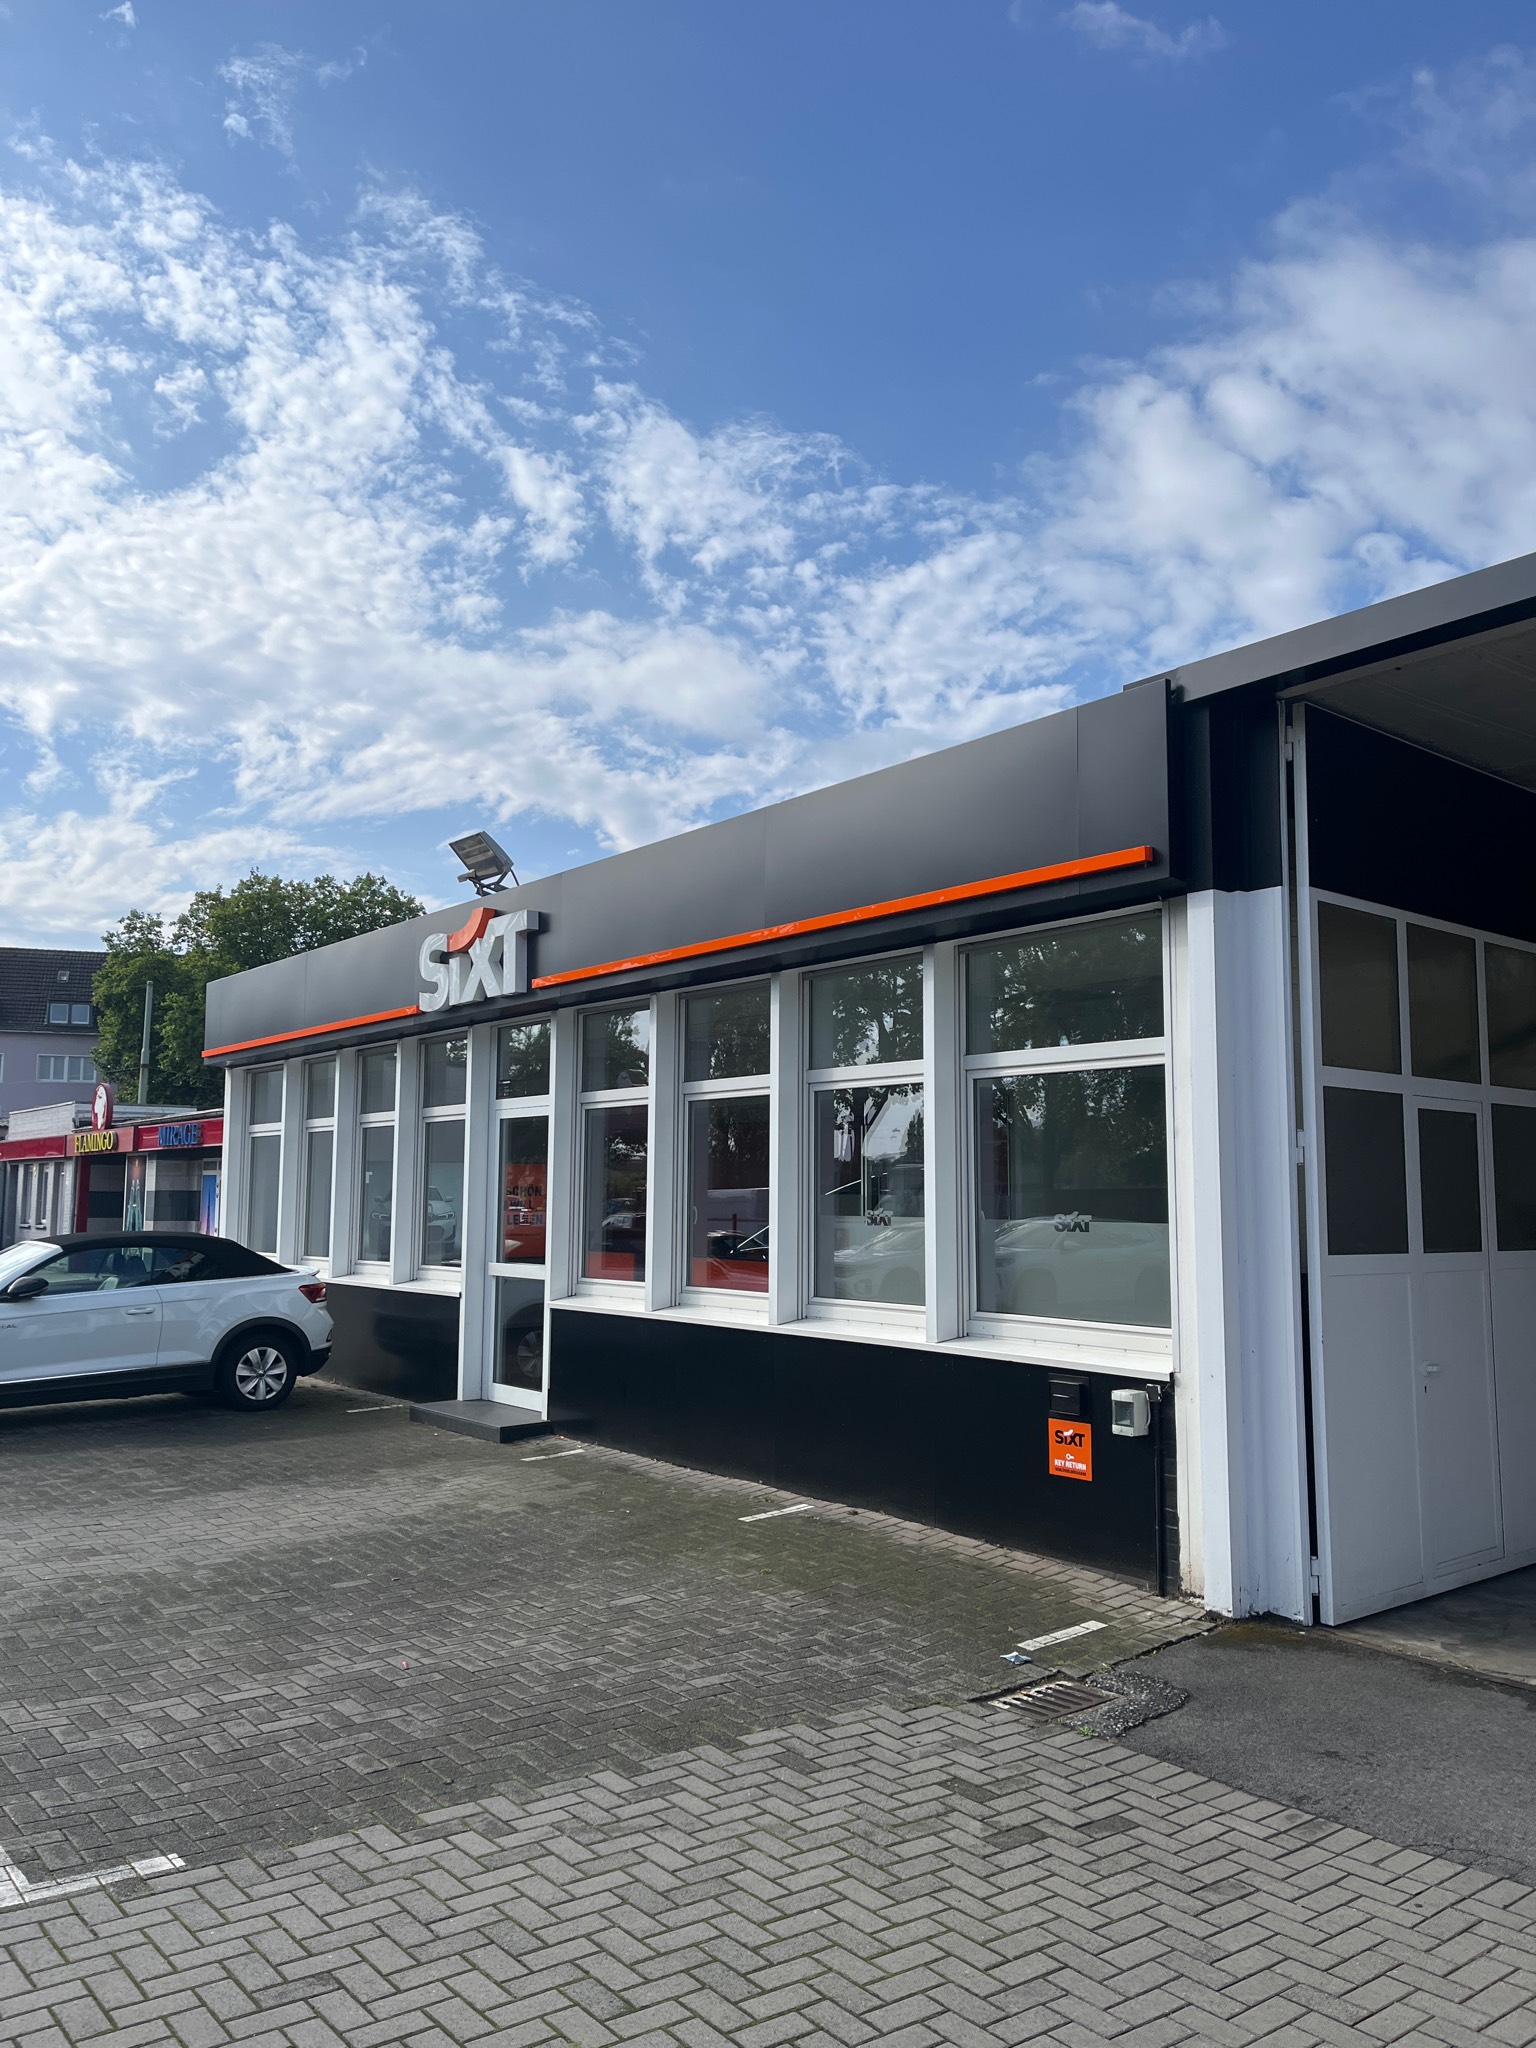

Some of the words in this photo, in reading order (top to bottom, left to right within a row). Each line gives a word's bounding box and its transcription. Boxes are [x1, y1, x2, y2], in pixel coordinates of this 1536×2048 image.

[74, 1131, 116, 1153] FLAMINGO
[158, 1123, 201, 1147] MIRAGE
[1054, 1459, 1065, 1467] KEY
[1065, 1460, 1087, 1471] RETURN
